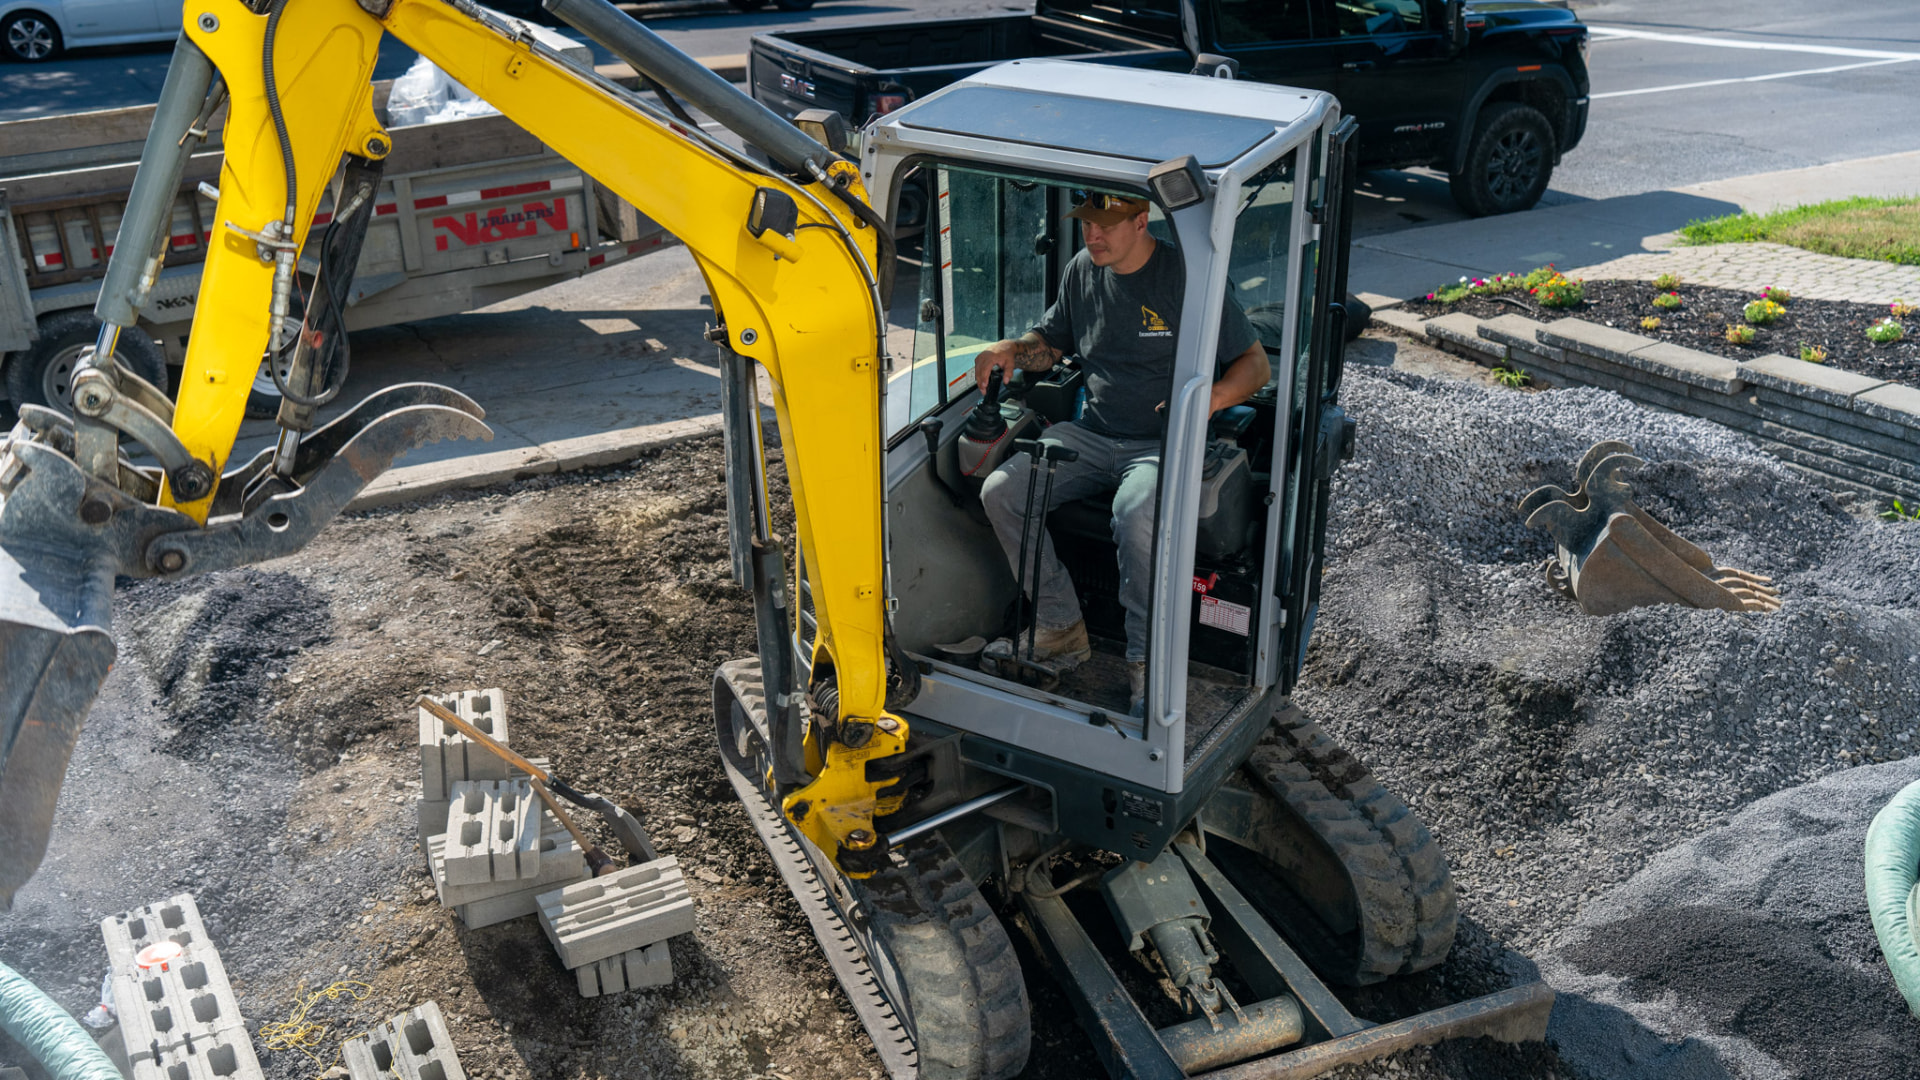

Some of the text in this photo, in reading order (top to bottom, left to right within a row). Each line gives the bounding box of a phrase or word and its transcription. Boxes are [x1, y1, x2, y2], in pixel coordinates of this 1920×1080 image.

[781, 73, 815, 98] GMC
[1424, 121, 1445, 129] HD
[432, 198, 568, 251] N&N
[480, 207, 553, 228] TRAILERS
